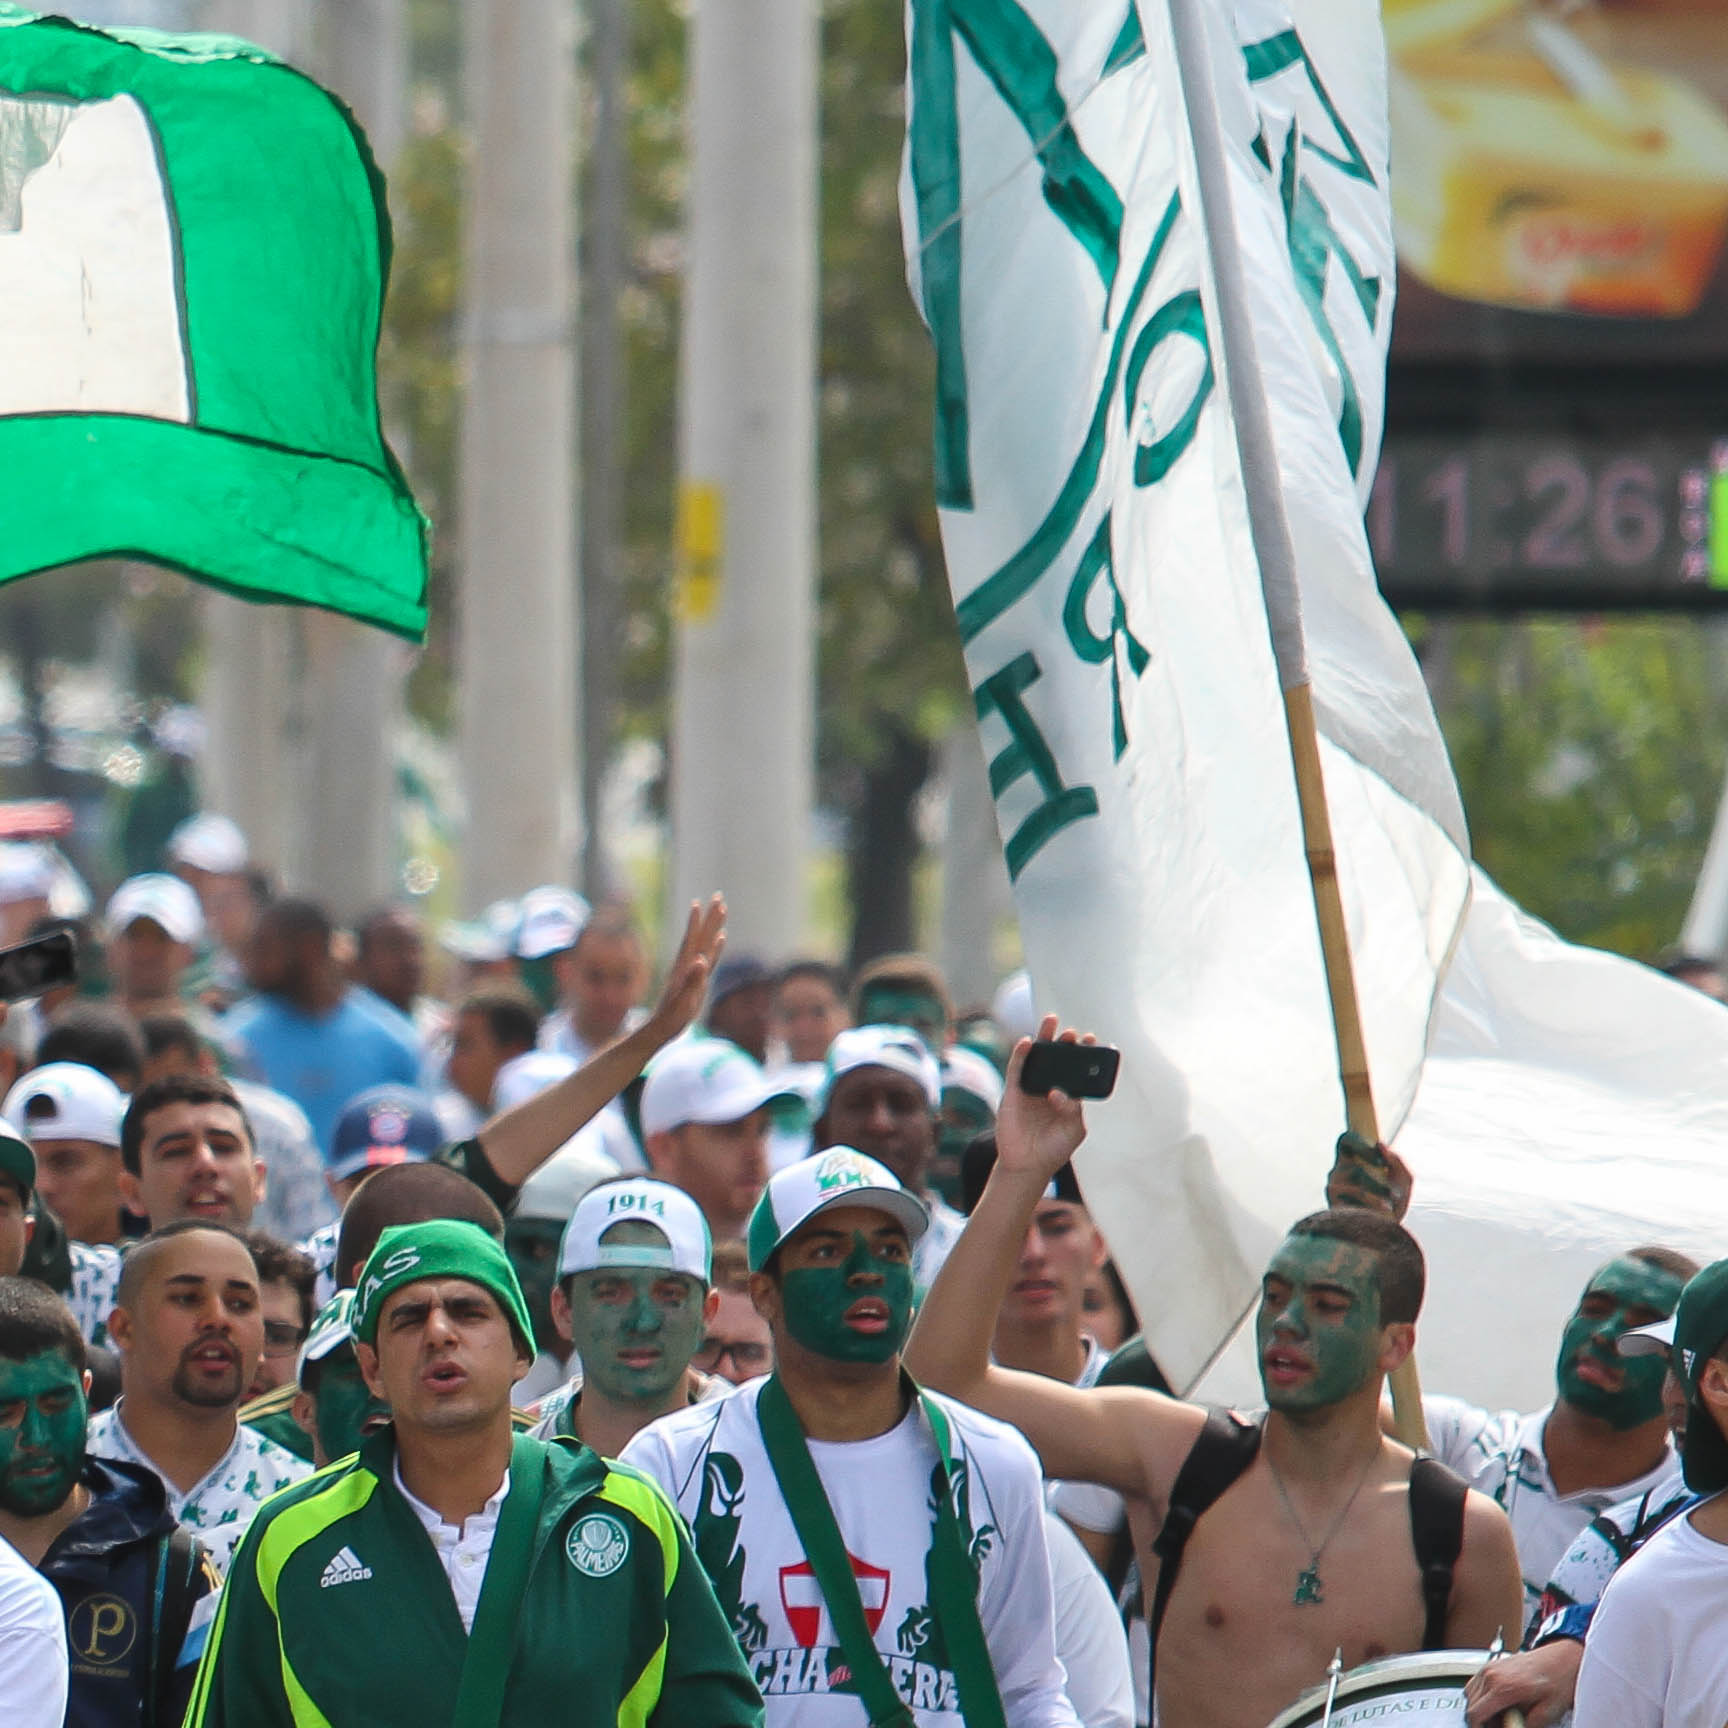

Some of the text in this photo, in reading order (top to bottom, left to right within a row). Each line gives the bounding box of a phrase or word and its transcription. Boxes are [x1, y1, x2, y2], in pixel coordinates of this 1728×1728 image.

[608, 1194, 665, 1216] 1914
[320, 1567, 373, 1588] adidas
[85, 1602, 126, 1657] P
[750, 1648, 831, 1694] CHA
[1352, 1699, 1414, 1722] LUTAS
